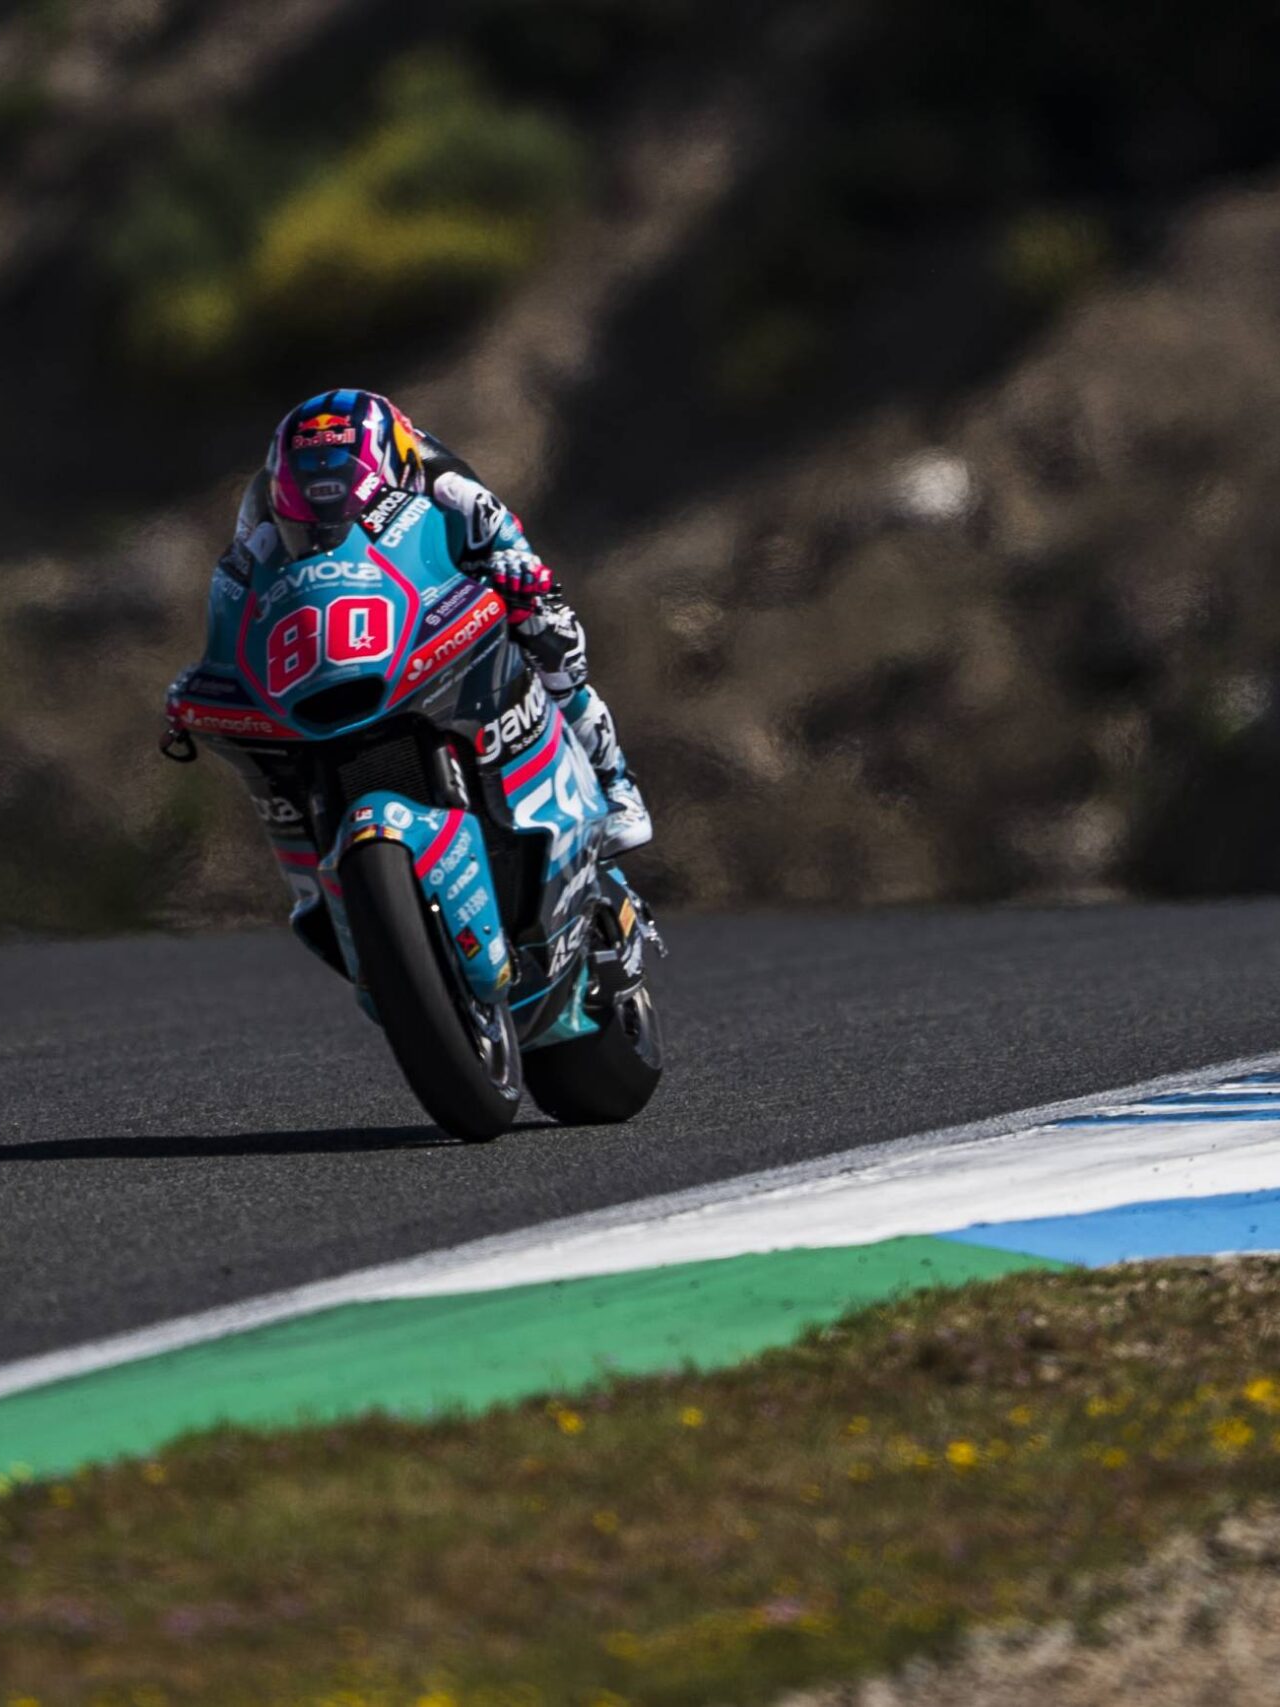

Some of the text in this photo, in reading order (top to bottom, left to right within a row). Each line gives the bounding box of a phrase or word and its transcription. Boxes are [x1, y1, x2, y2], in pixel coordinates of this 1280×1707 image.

[292, 427, 356, 449] Red Bull
[363, 490, 408, 534] gaviota
[380, 496, 433, 548] CFMOTO
[254, 560, 383, 623] gaviota
[266, 595, 395, 697] 80
[434, 600, 500, 661] mapfre
[202, 716, 273, 734] mapfre
